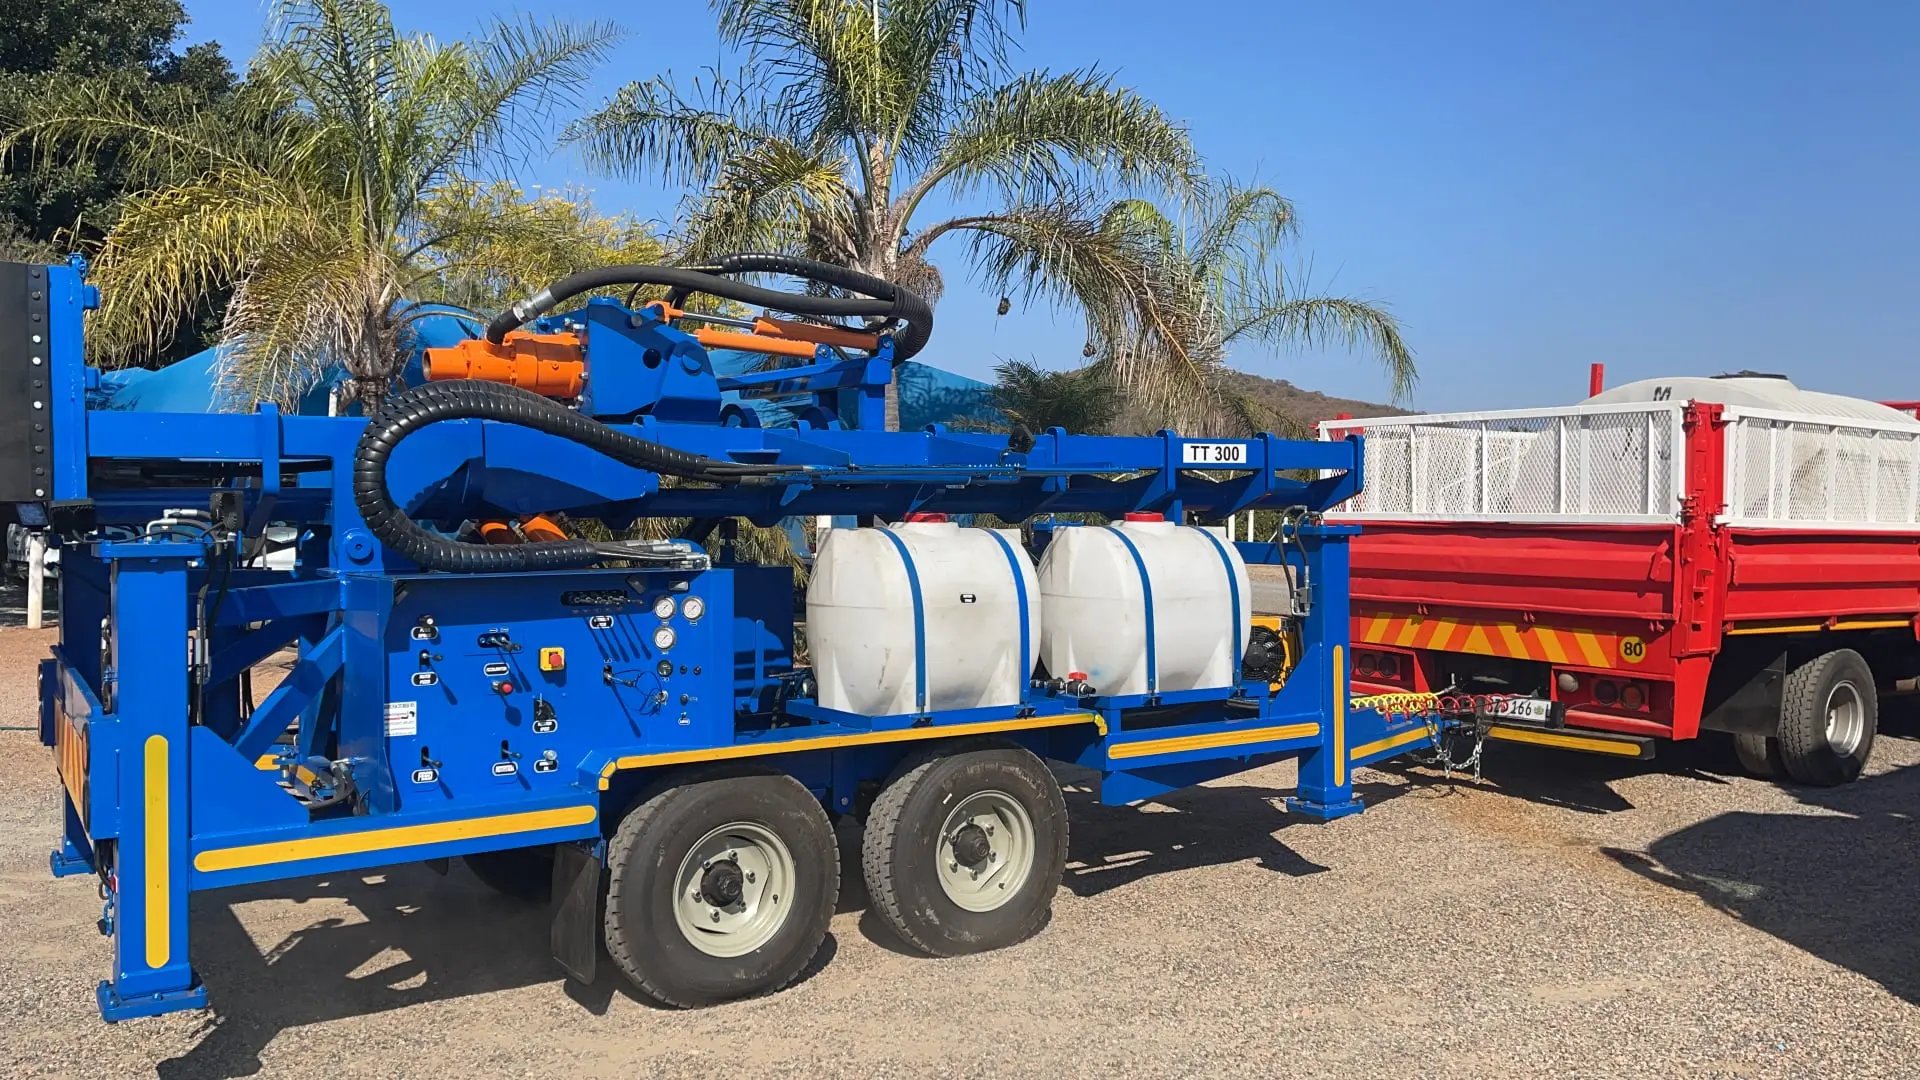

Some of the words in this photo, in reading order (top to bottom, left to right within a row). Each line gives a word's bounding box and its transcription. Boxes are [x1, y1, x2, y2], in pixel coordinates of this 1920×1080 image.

[1190, 446, 1210, 461] TT
[1215, 446, 1239, 461] 300
[1624, 641, 1643, 656] 80
[1510, 701, 1532, 716] 166
